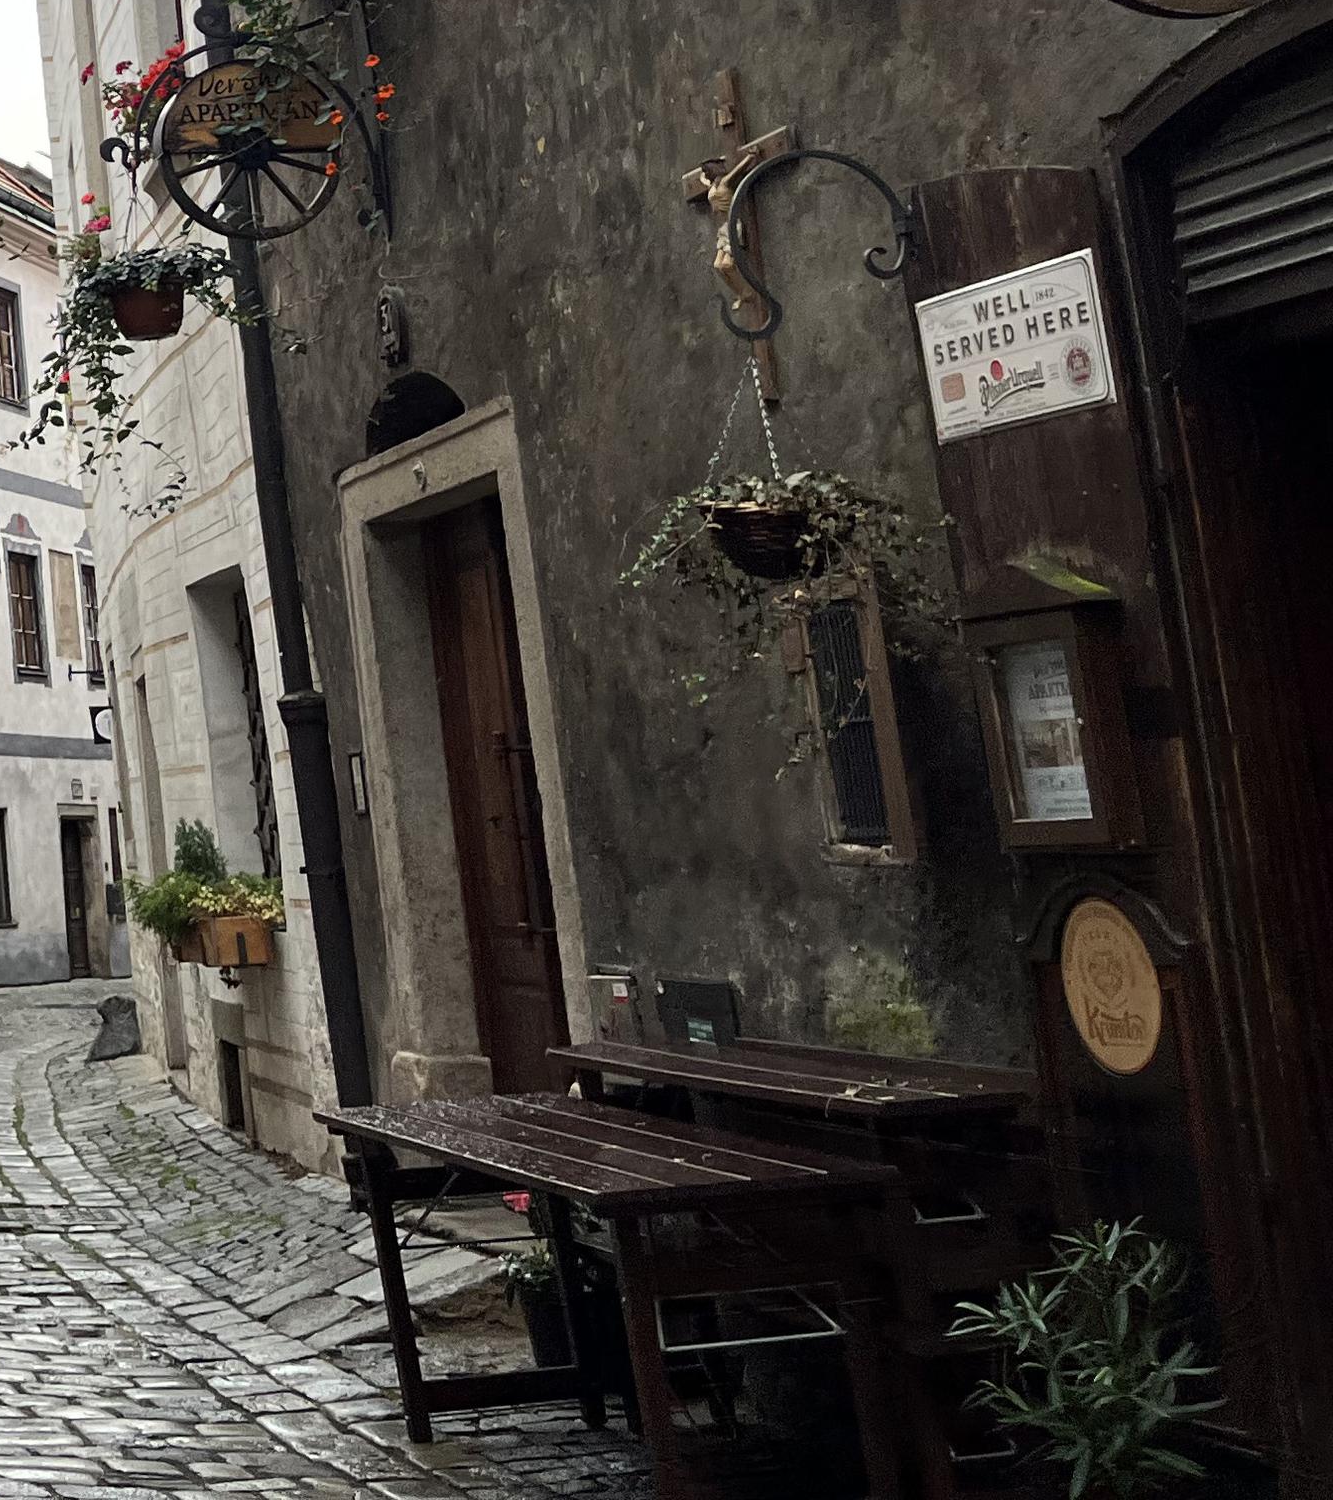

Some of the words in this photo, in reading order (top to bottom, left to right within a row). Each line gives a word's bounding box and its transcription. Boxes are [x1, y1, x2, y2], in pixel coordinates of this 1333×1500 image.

[973, 289, 1030, 324] WELL
[1035, 287, 1055, 302] 1842
[933, 323, 1015, 366] SERVED
[1025, 301, 1090, 340] HERE
